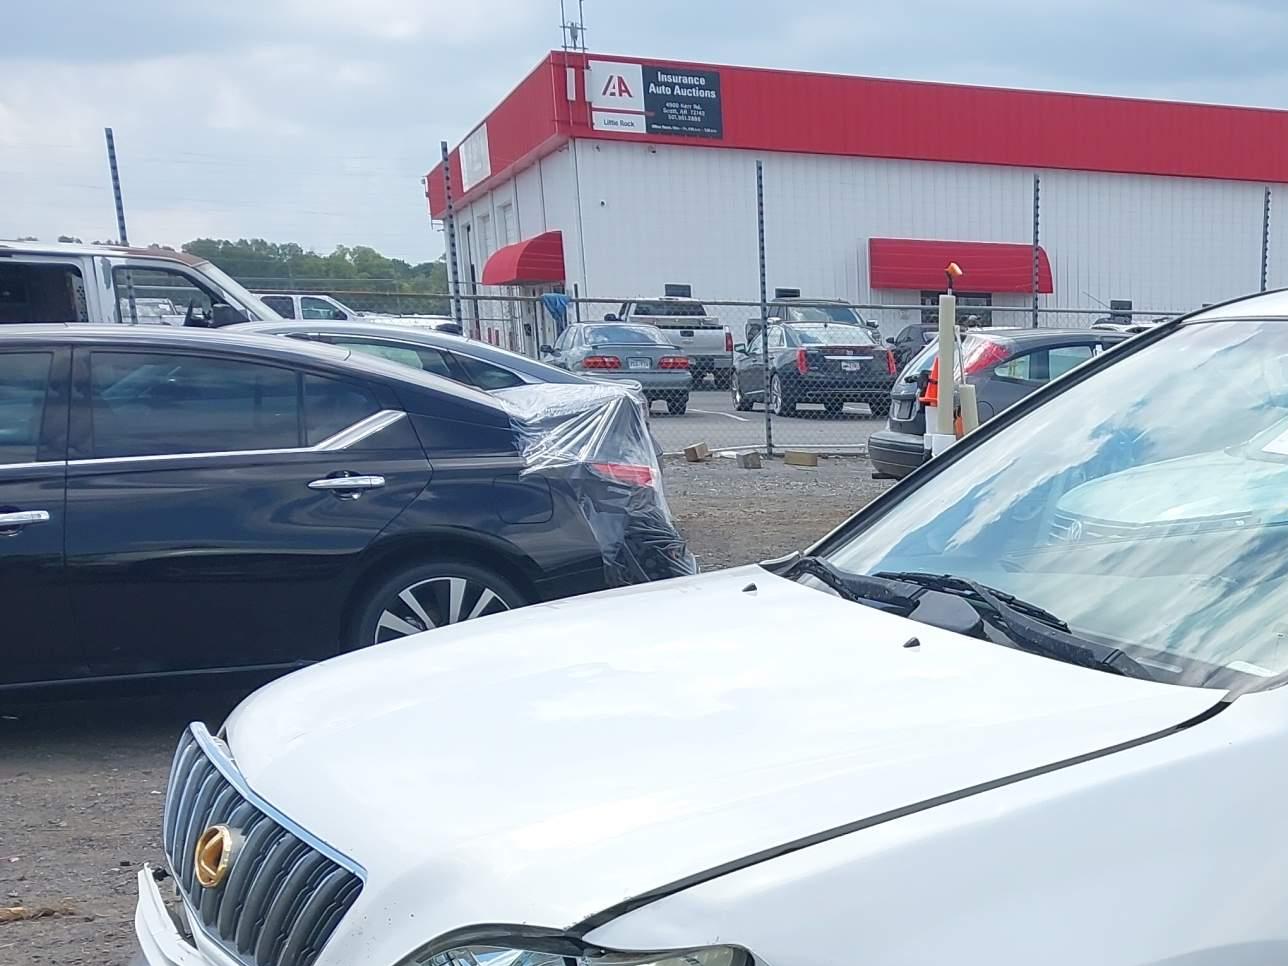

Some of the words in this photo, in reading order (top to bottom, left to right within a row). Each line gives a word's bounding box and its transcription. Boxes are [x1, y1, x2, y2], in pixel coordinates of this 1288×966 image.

[657, 71, 705, 85] Insurance
[648, 83, 672, 95] Auto
[673, 85, 716, 98] Auctions
[603, 119, 619, 127] Little
[619, 119, 635, 127] Rock
